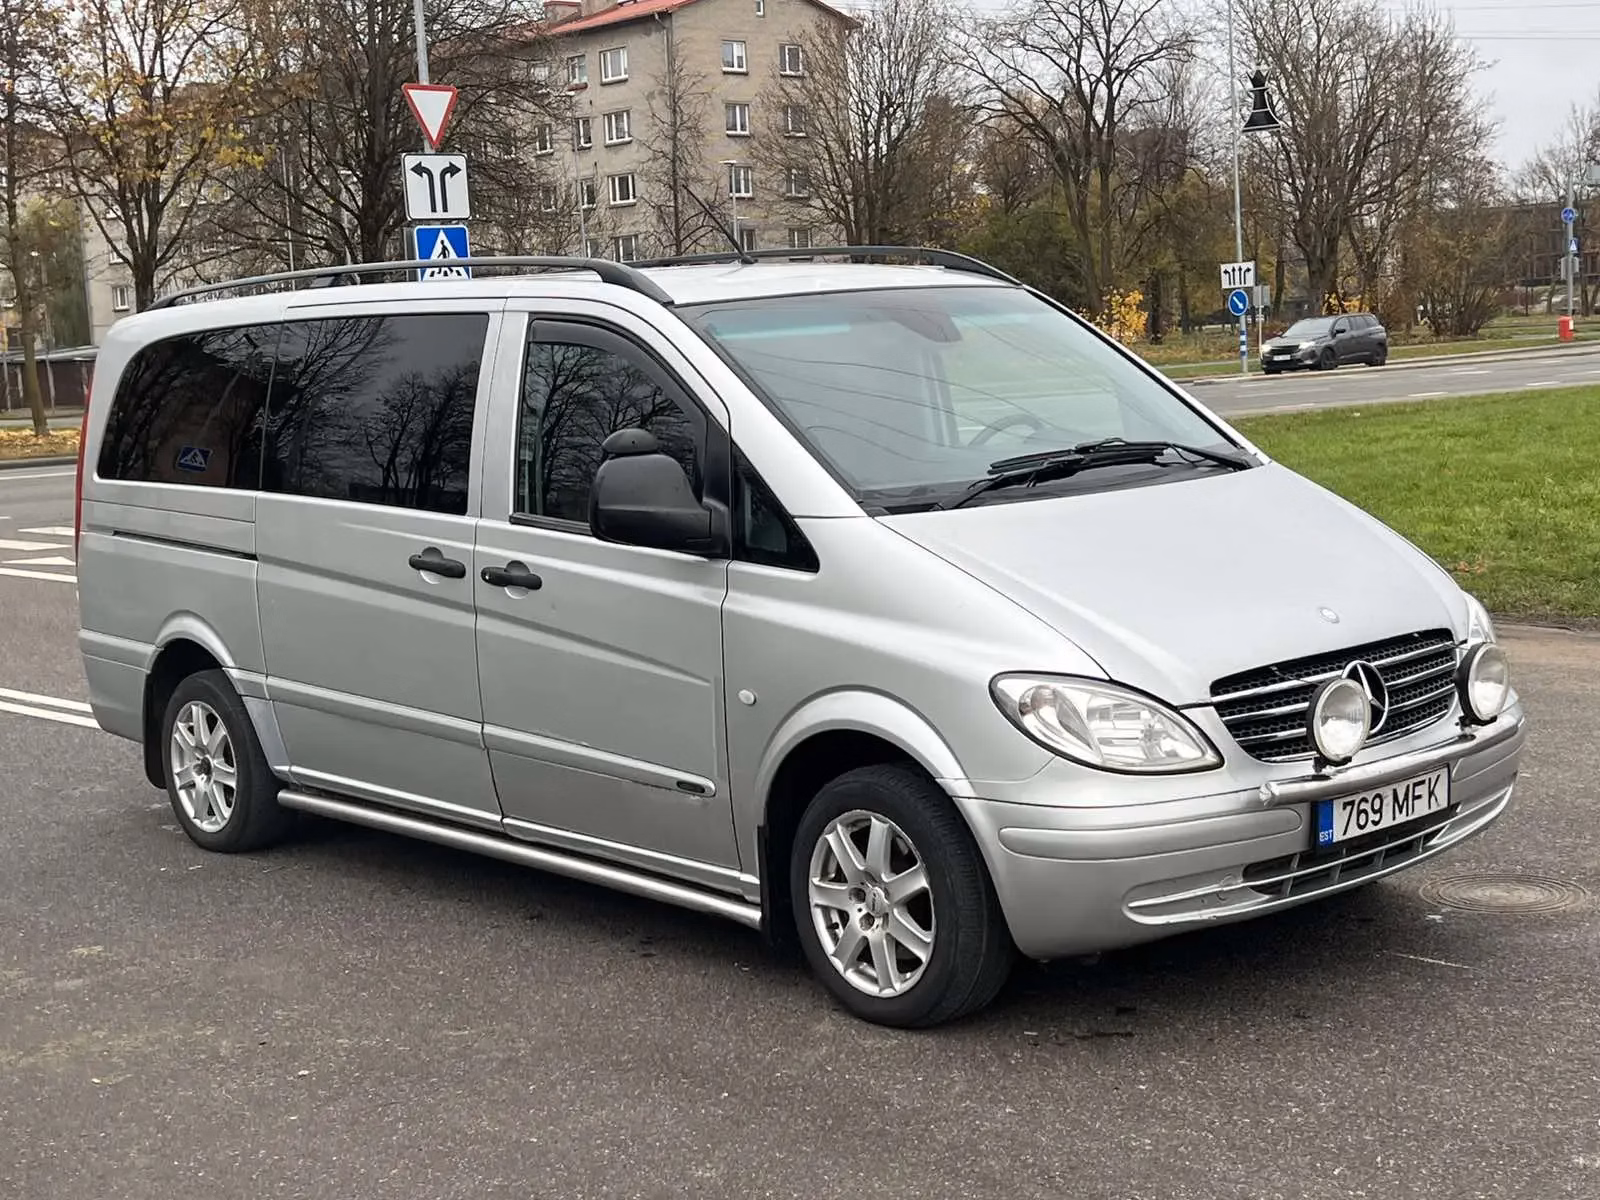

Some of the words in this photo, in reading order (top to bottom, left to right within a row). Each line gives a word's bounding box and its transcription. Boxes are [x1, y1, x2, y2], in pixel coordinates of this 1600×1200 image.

[1342, 793, 1384, 836] 769
[1392, 774, 1441, 821] MFK
[1319, 829, 1333, 842] EST
